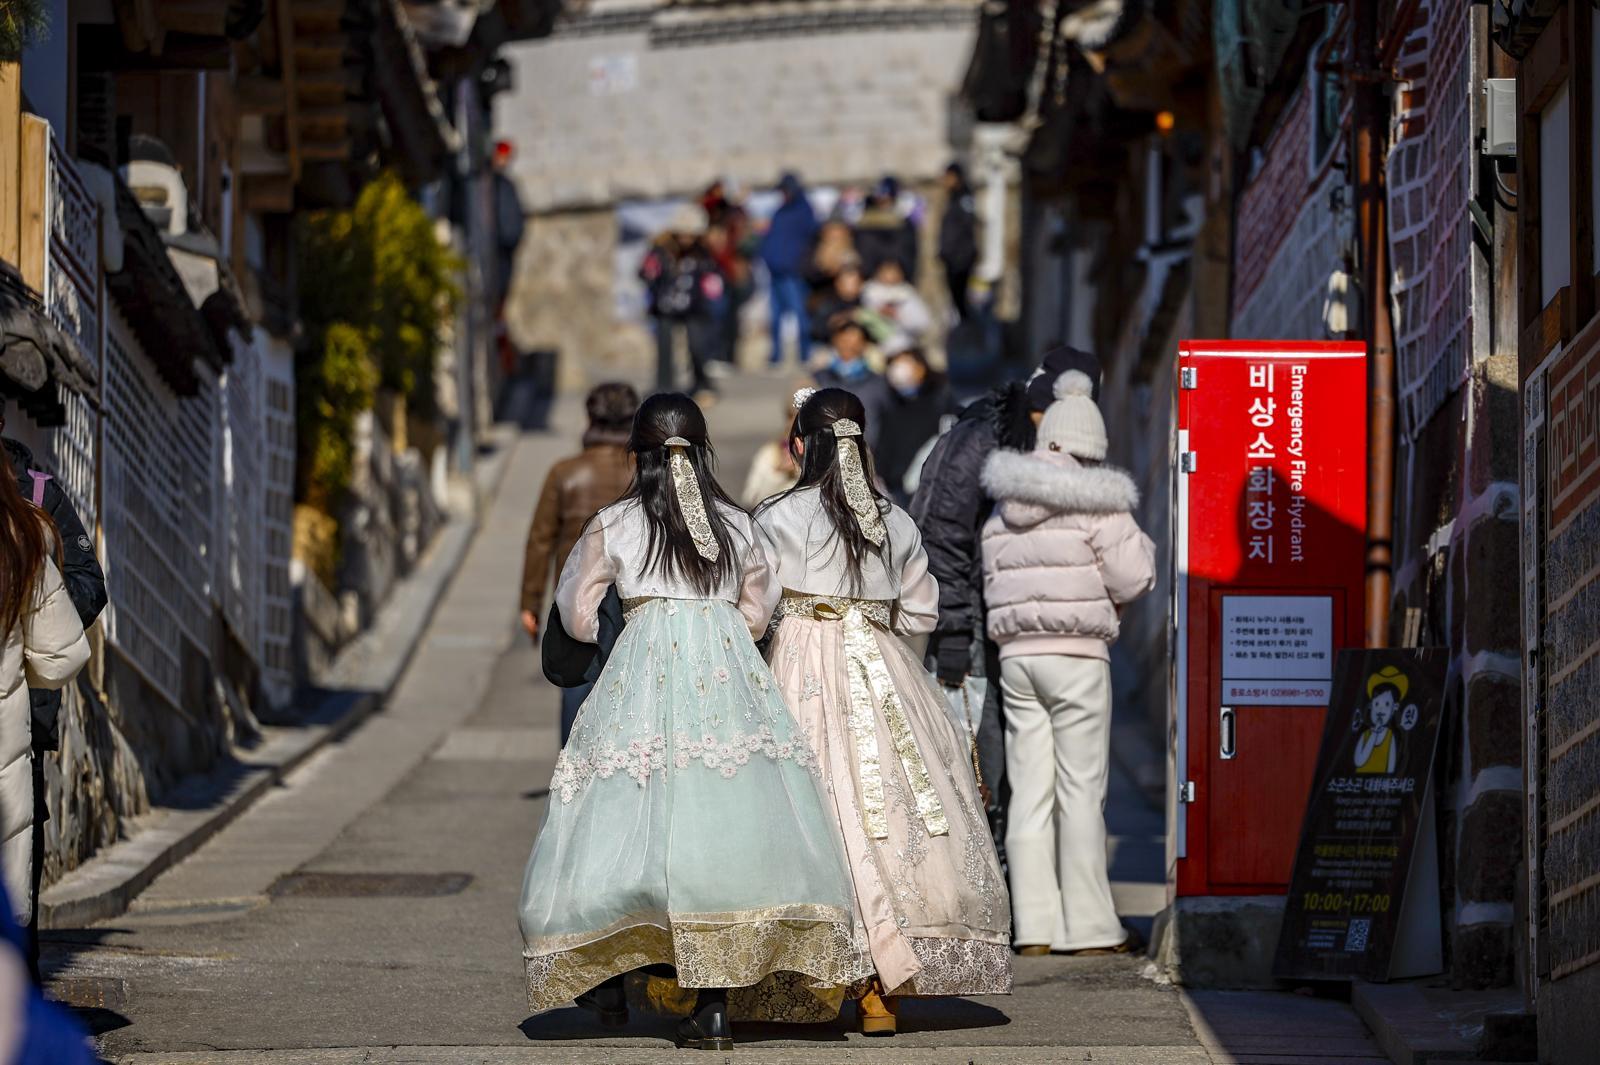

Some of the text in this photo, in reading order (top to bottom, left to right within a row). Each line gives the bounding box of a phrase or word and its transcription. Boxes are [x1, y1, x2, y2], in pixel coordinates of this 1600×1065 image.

[1247, 363, 1276, 564] 비상소화장치
[1287, 365, 1307, 562] Emergency Fire Hydrant
[1327, 777, 1363, 793] 소곤소곤
[1303, 892, 1390, 912] 10:00~17:00
